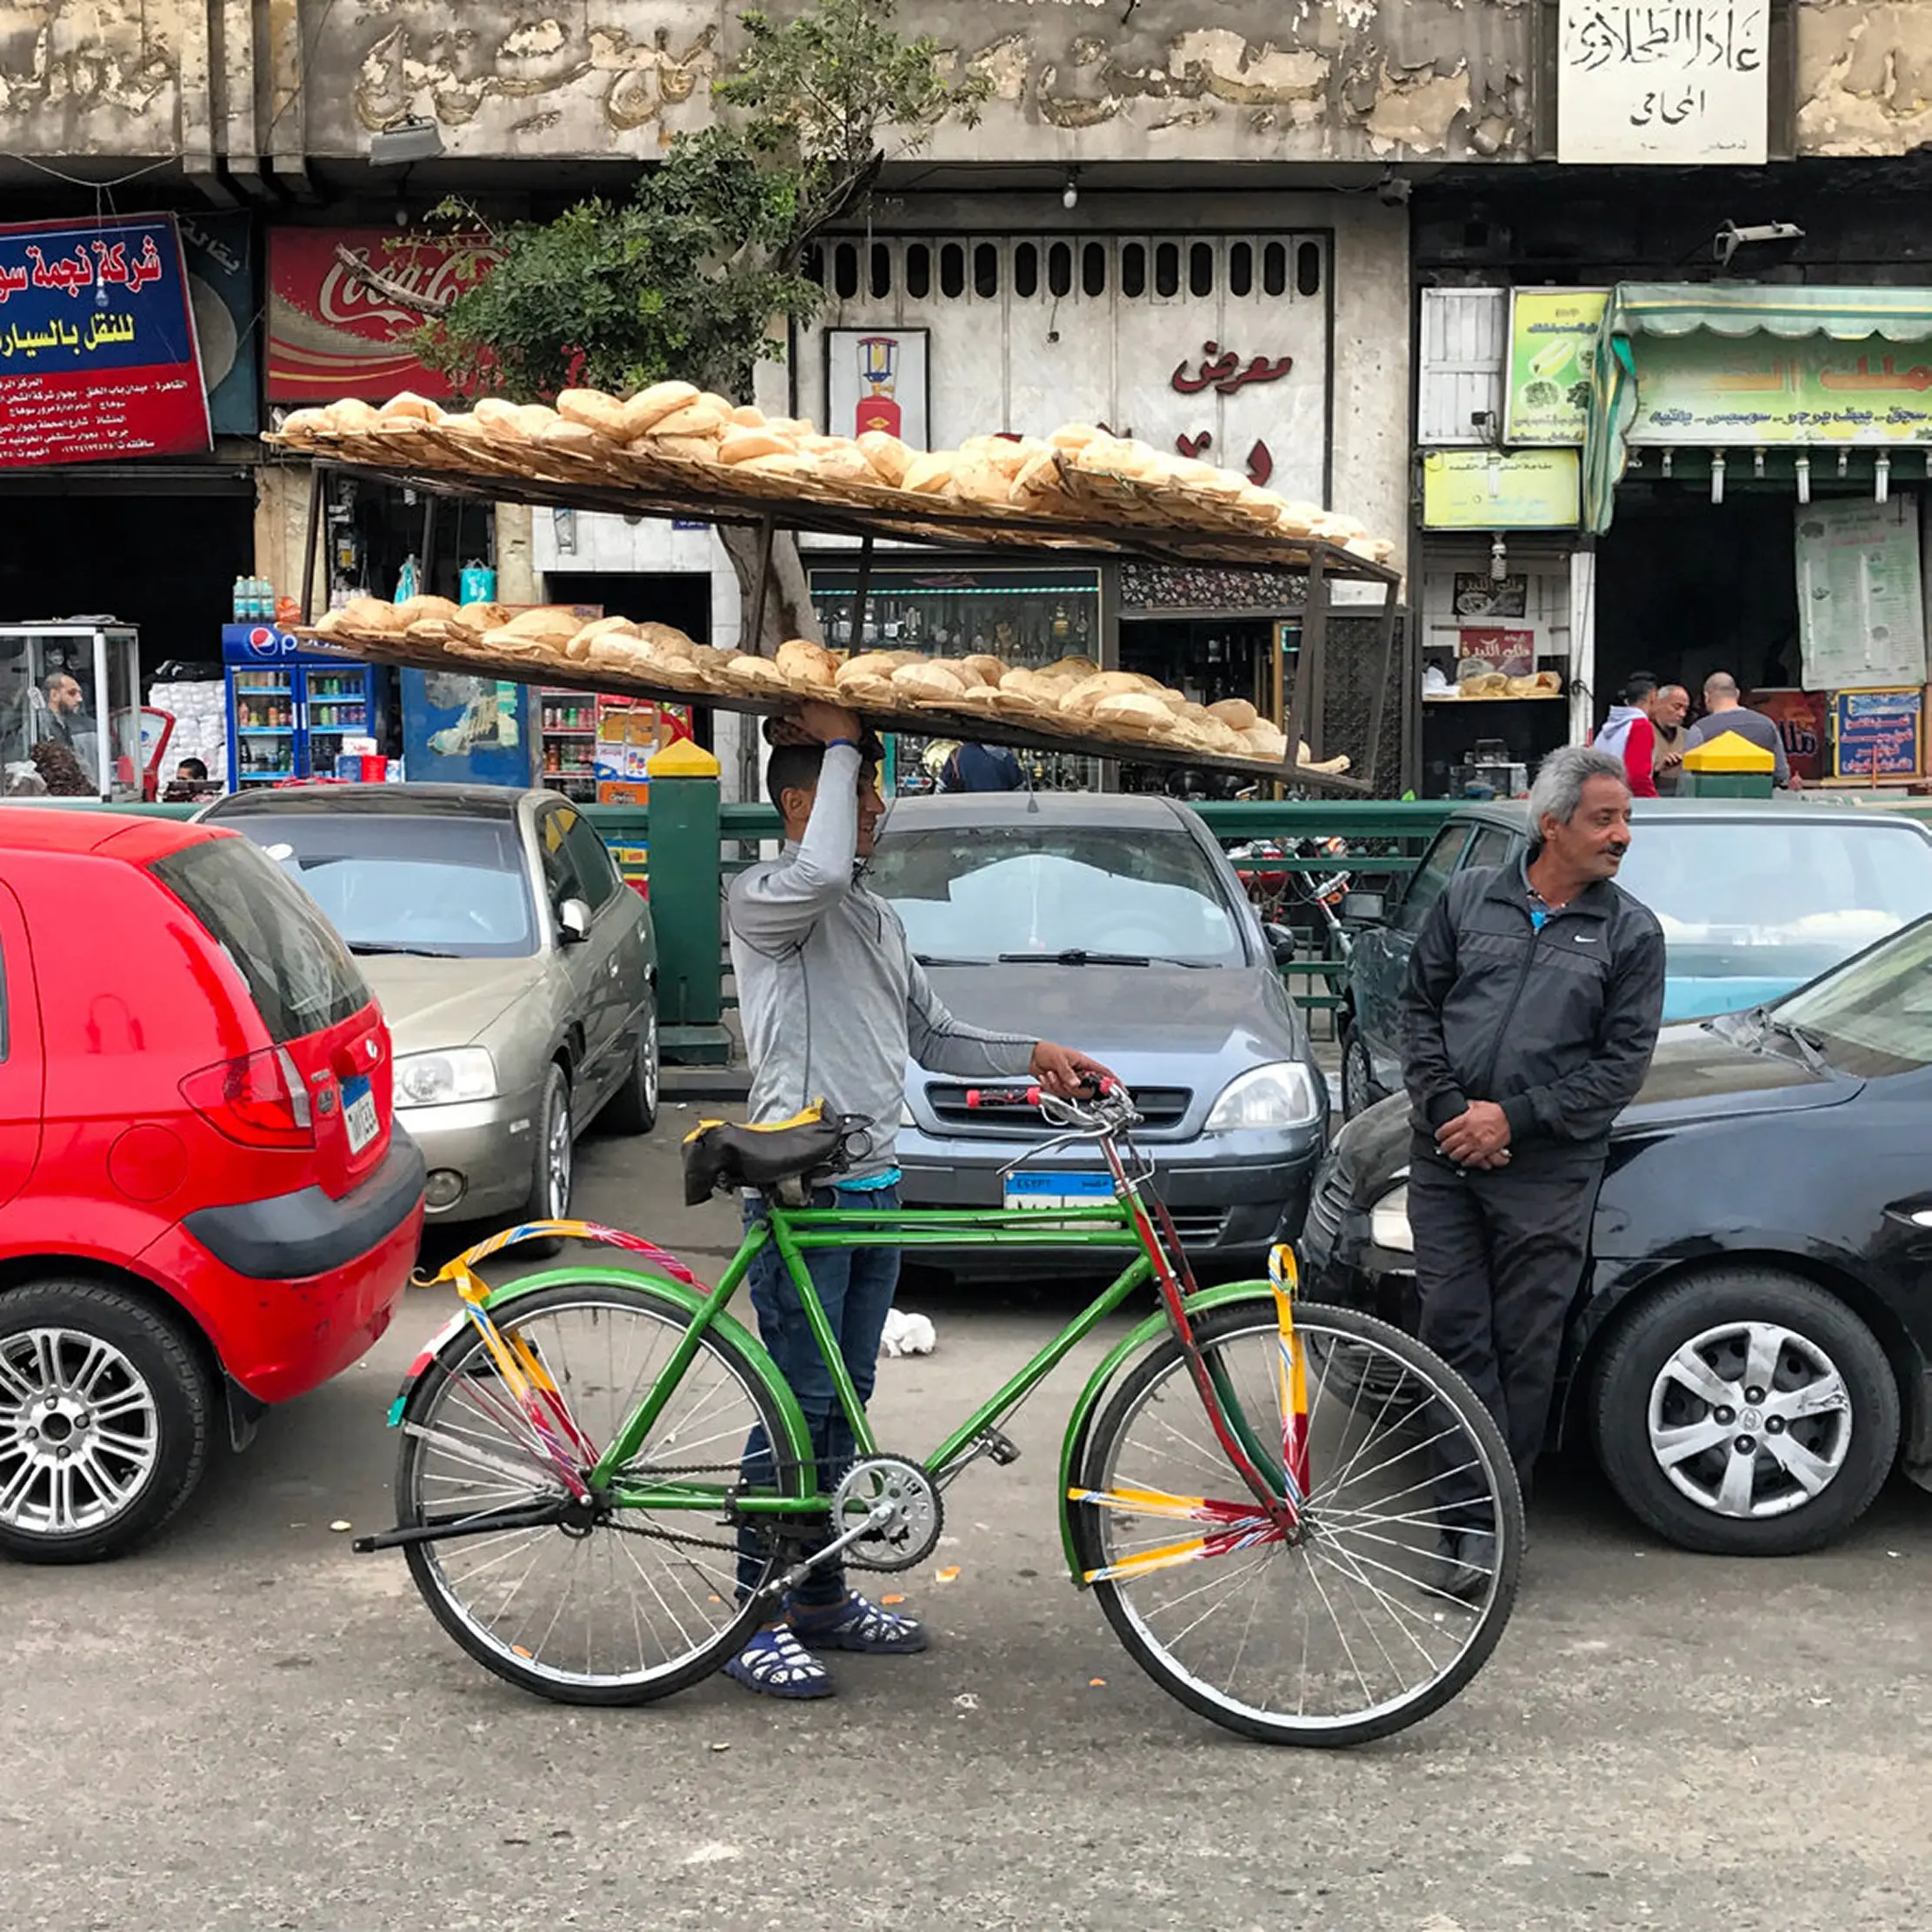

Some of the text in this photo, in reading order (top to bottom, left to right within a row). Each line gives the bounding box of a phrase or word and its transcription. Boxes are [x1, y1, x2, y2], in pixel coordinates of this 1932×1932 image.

[32, 243, 94, 297] نجمة
[91, 235, 162, 293] شركة
[318, 246, 506, 325] Coca-Co
[0, 311, 135, 358] للنقل بالسيار
[1170, 340, 1296, 396] معرض
